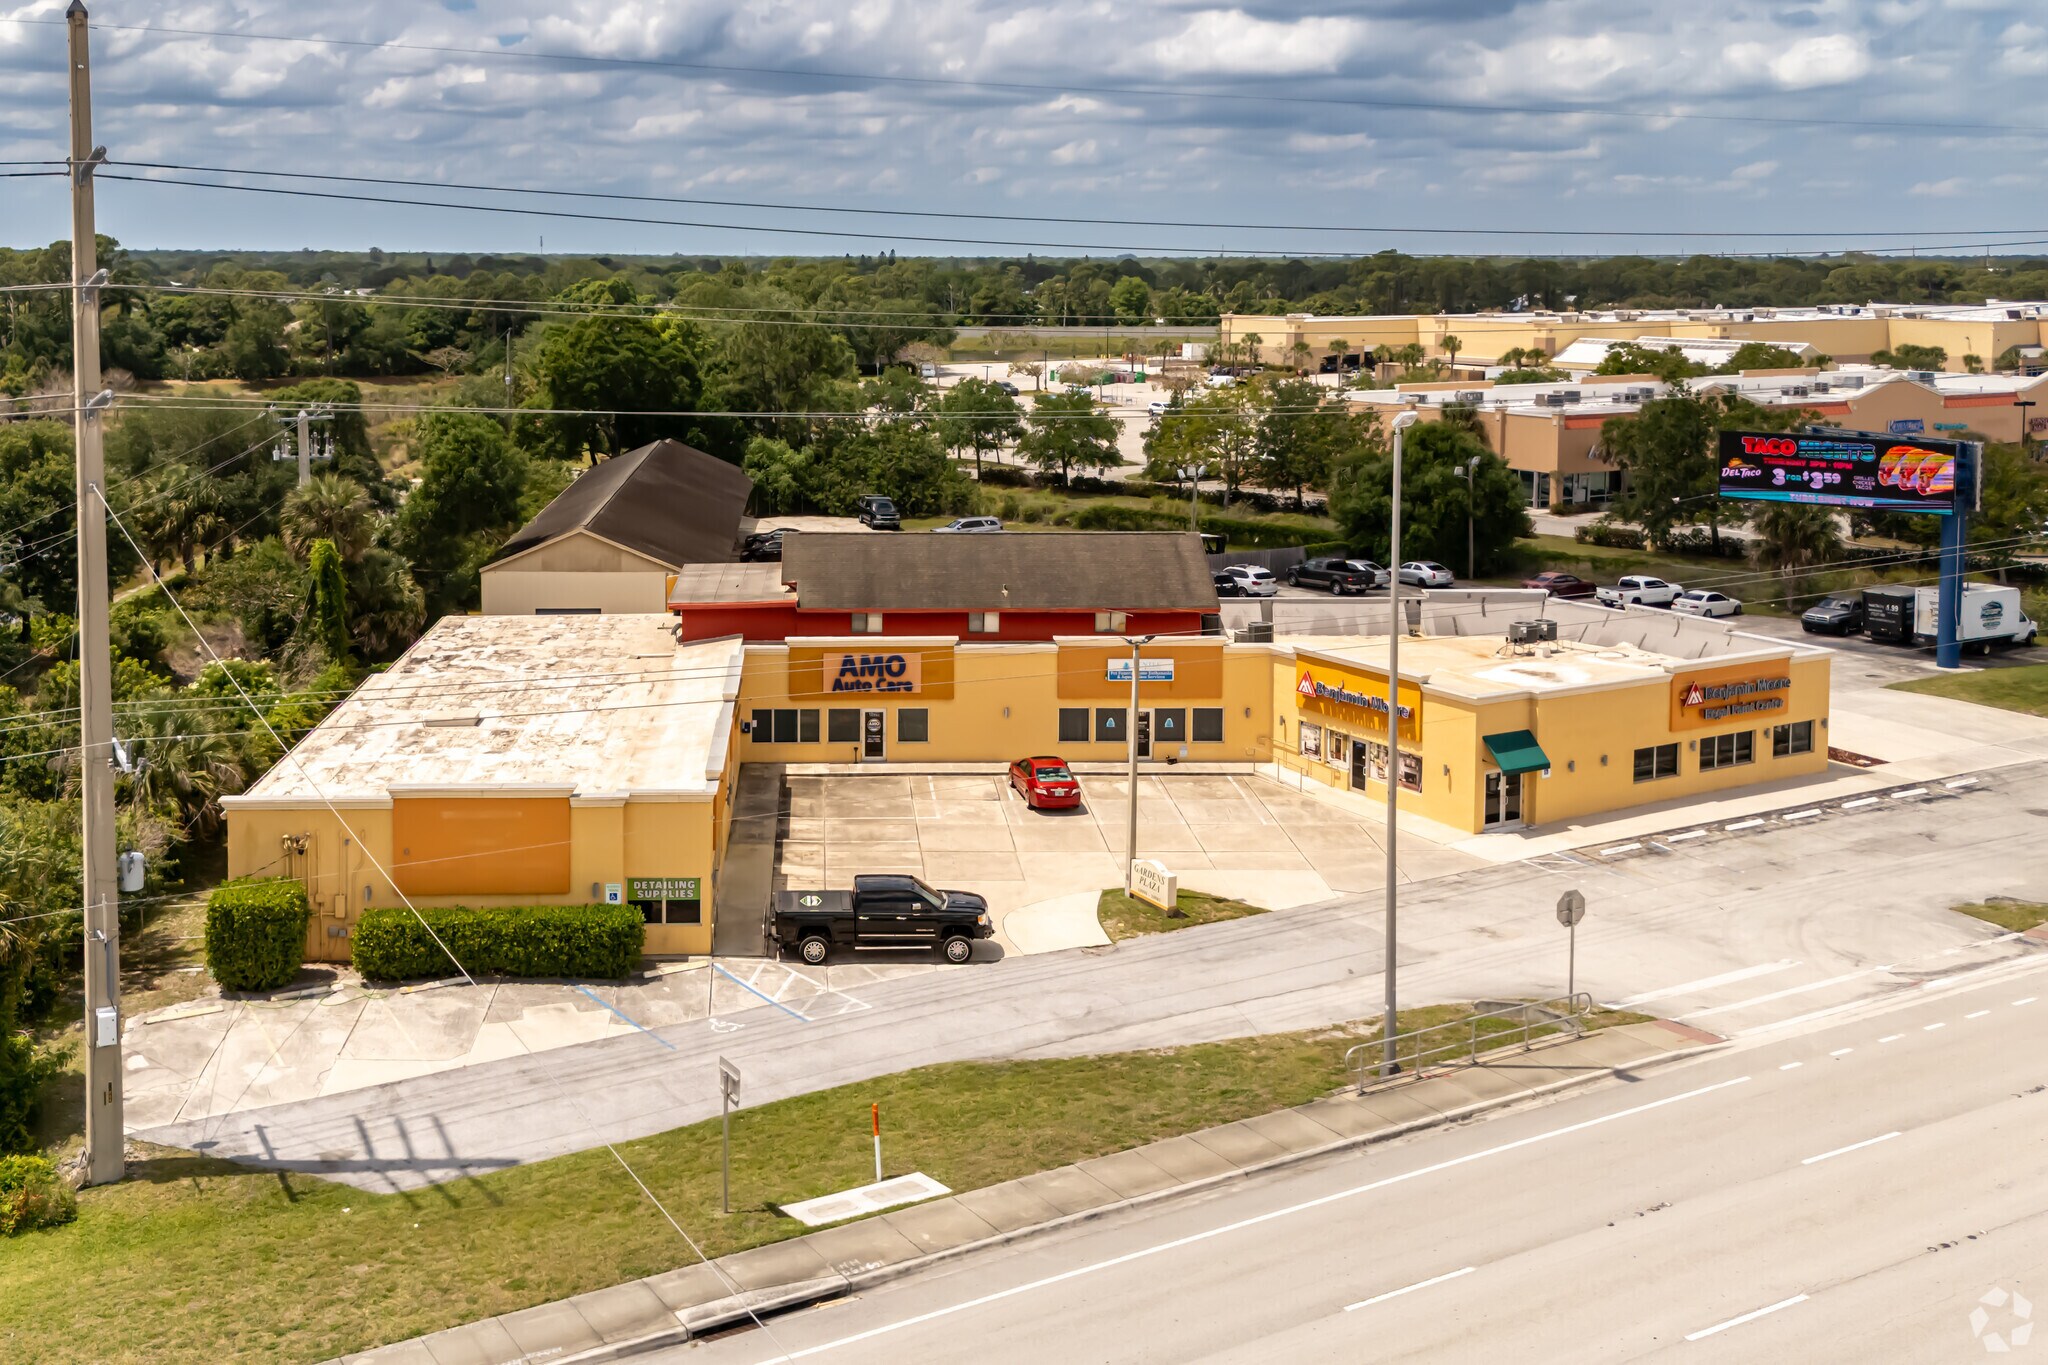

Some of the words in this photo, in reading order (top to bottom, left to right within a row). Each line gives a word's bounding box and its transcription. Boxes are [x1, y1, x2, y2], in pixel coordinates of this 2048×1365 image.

[1742, 436, 1796, 456] TACO
[1798, 440, 1876, 462] NIGHTS
[1721, 467, 1740, 477] DEL
[1739, 468, 1762, 478] TACO
[1772, 468, 1786, 486] 3
[1786, 473, 1802, 481] FOR
[1789, 493, 1816, 502] TURN
[1849, 498, 1875, 506] NOW
[840, 655, 906, 677] AMO
[832, 678, 873, 692] Auto
[876, 677, 913, 692] Care
[1705, 681, 1755, 700] Benjamin
[1756, 677, 1791, 692] Moore
[1315, 681, 1369, 707] Benjamin
[1370, 696, 1410, 718] More
[1756, 698, 1784, 710] Center
[1134, 864, 1165, 885] GARDENS
[633, 880, 695, 889] DETAILING
[1139, 876, 1160, 893] PLAZA
[637, 889, 694, 898] SUPPLIES
